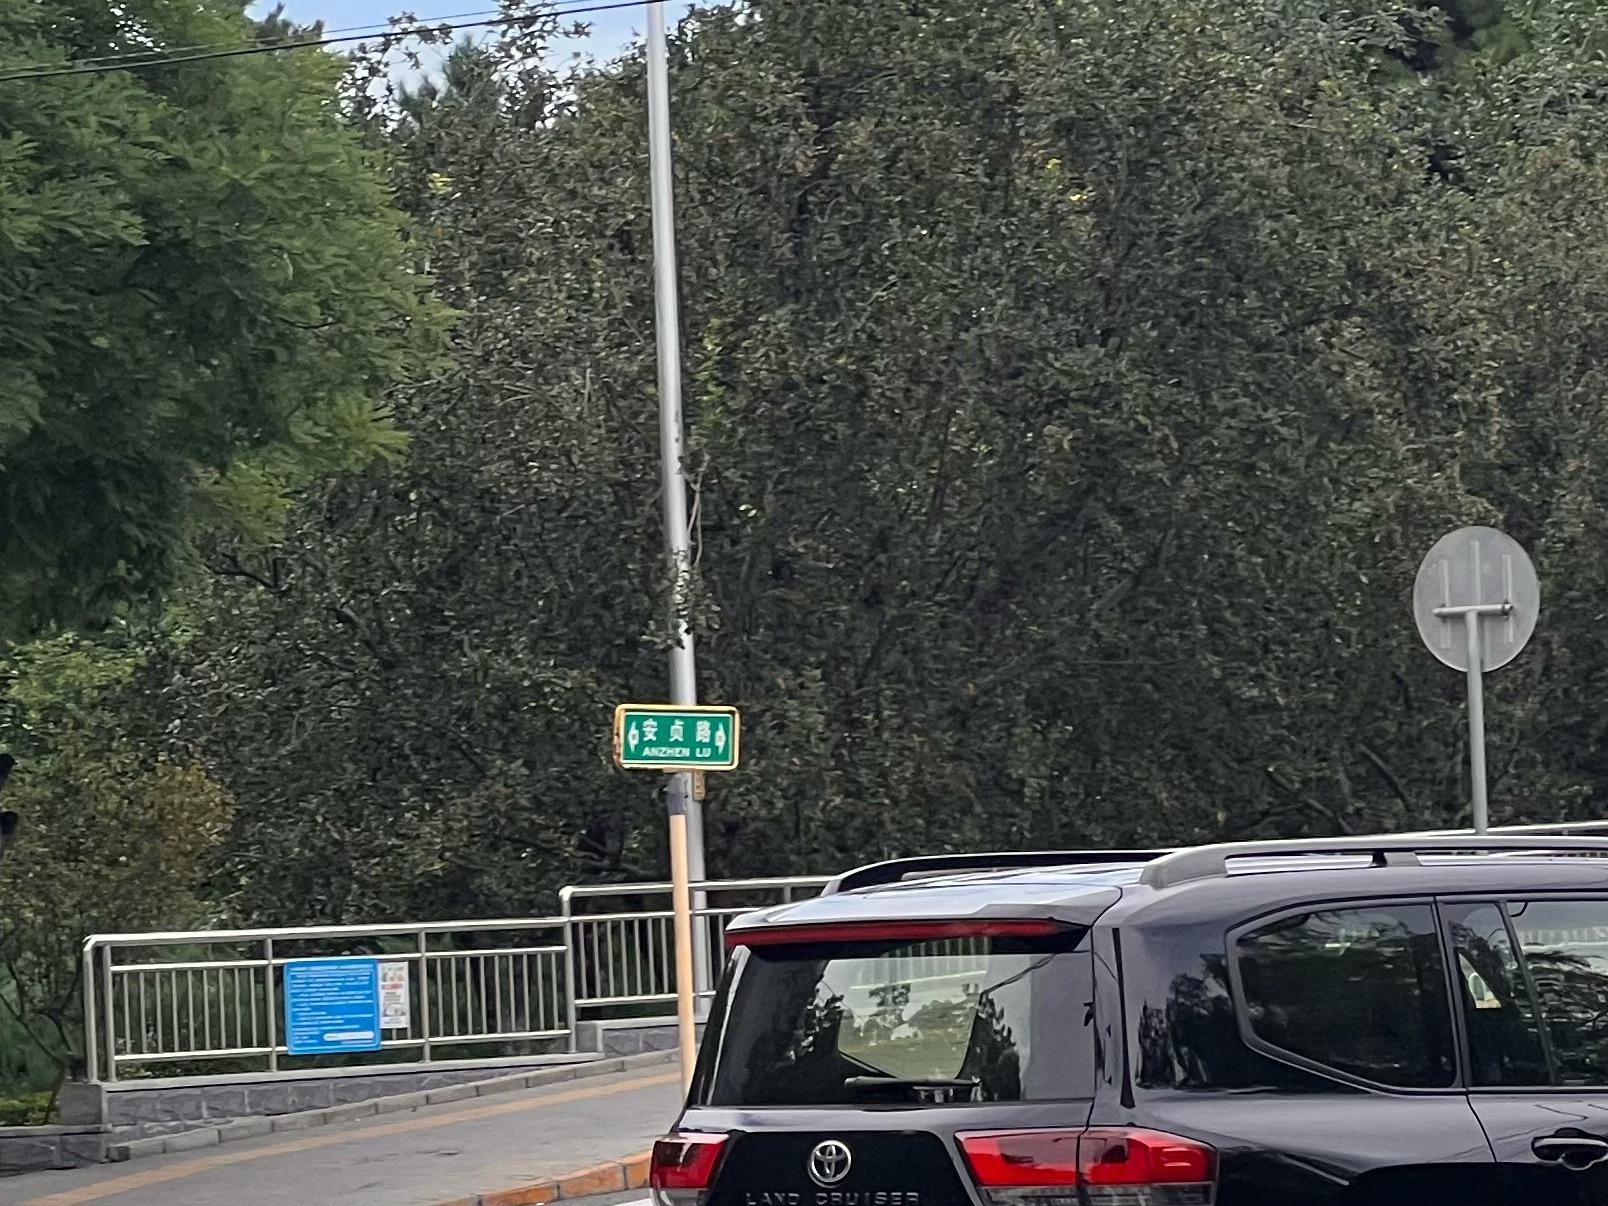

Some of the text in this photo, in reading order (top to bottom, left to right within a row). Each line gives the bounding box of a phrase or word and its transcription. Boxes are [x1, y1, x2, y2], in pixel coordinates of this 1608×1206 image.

[642, 718, 711, 743] 安贞路
[695, 747, 711, 758] LU
[746, 1191, 919, 1206] LAND CRUISER
